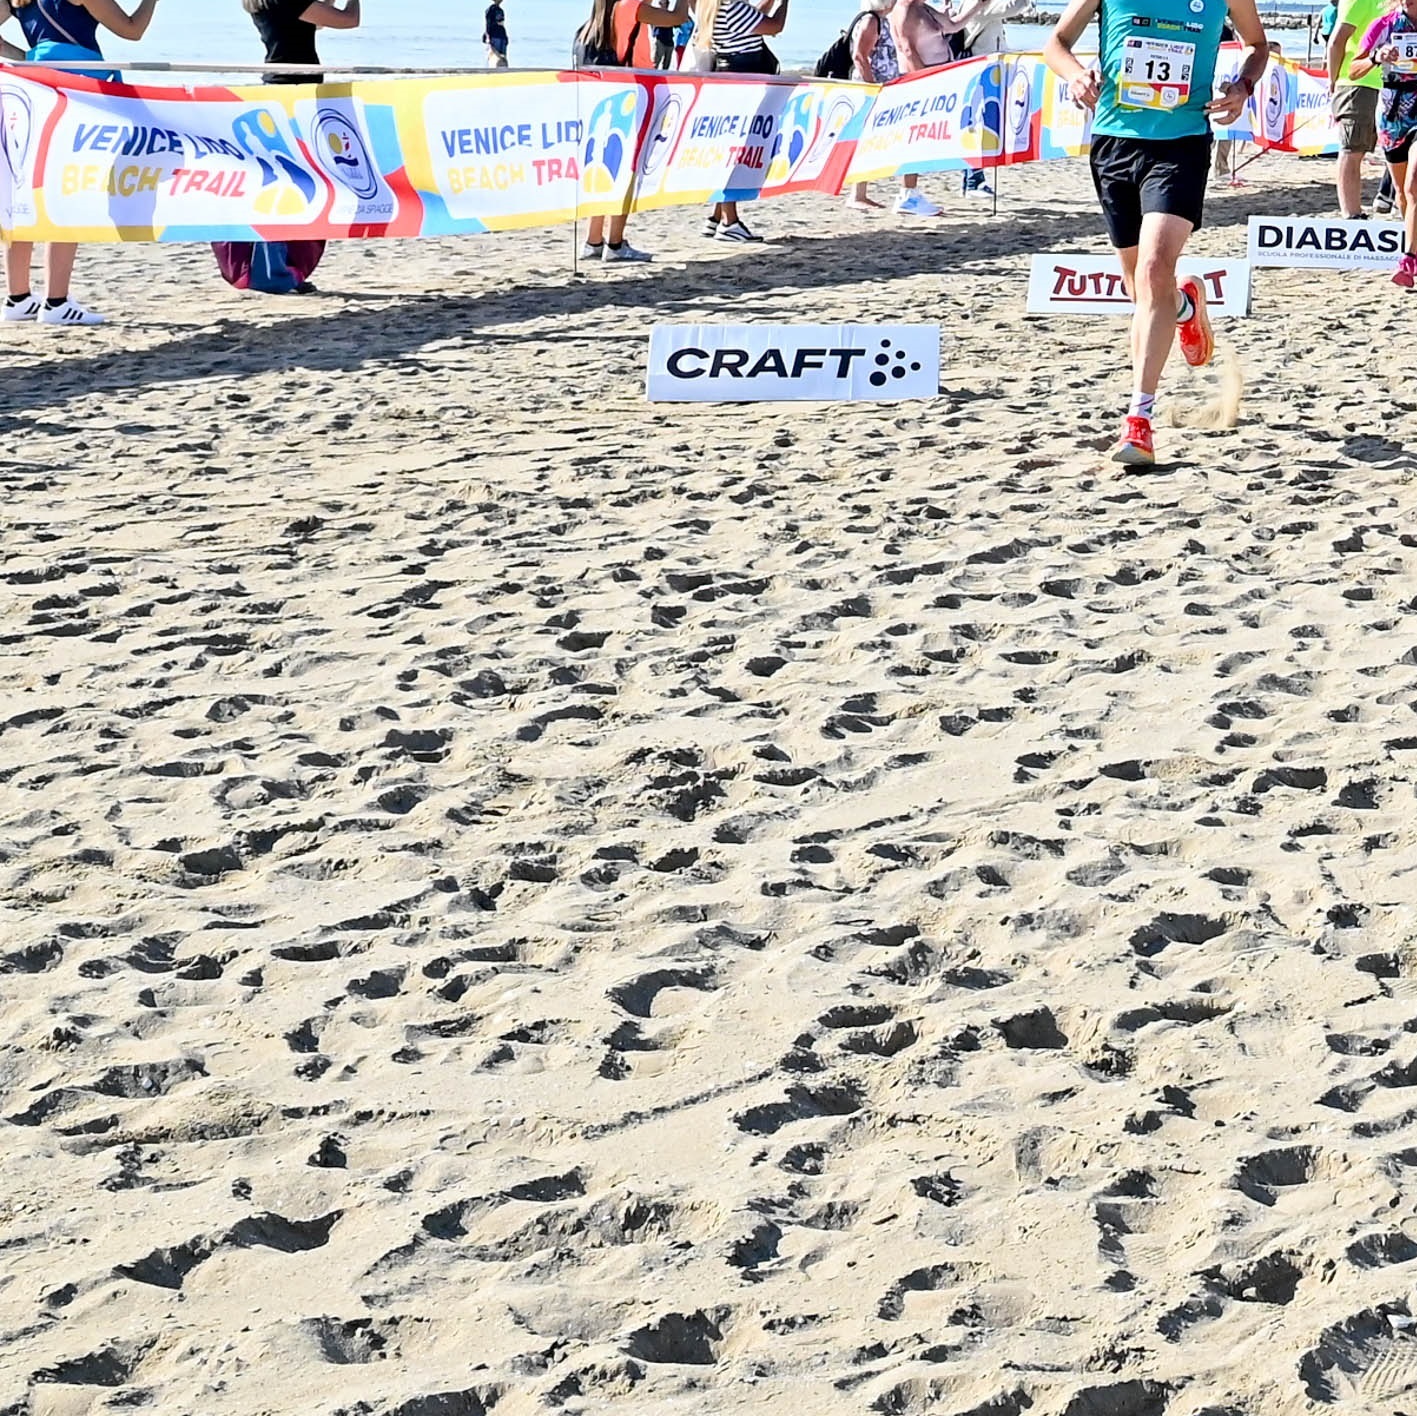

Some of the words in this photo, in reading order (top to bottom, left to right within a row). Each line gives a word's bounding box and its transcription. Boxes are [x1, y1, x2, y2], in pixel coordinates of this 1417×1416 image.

[1145, 59, 1171, 82] 13
[691, 115, 741, 139] VENICE
[740, 114, 774, 140] LIDO
[872, 99, 920, 131] VENICE
[920, 92, 957, 116] LIDO
[72, 124, 185, 157] VENICE
[185, 133, 246, 161] LIDO
[441, 123, 533, 158] VENICE
[908, 121, 952, 144] TRAIL
[678, 146, 724, 169] BEACH
[727, 146, 765, 169] TRAIL
[61, 163, 163, 197] BEACH
[168, 168, 248, 198] TRAIL
[447, 161, 525, 195] BEACH
[532, 157, 580, 186] TRA
[666, 347, 866, 379] CRAFT
